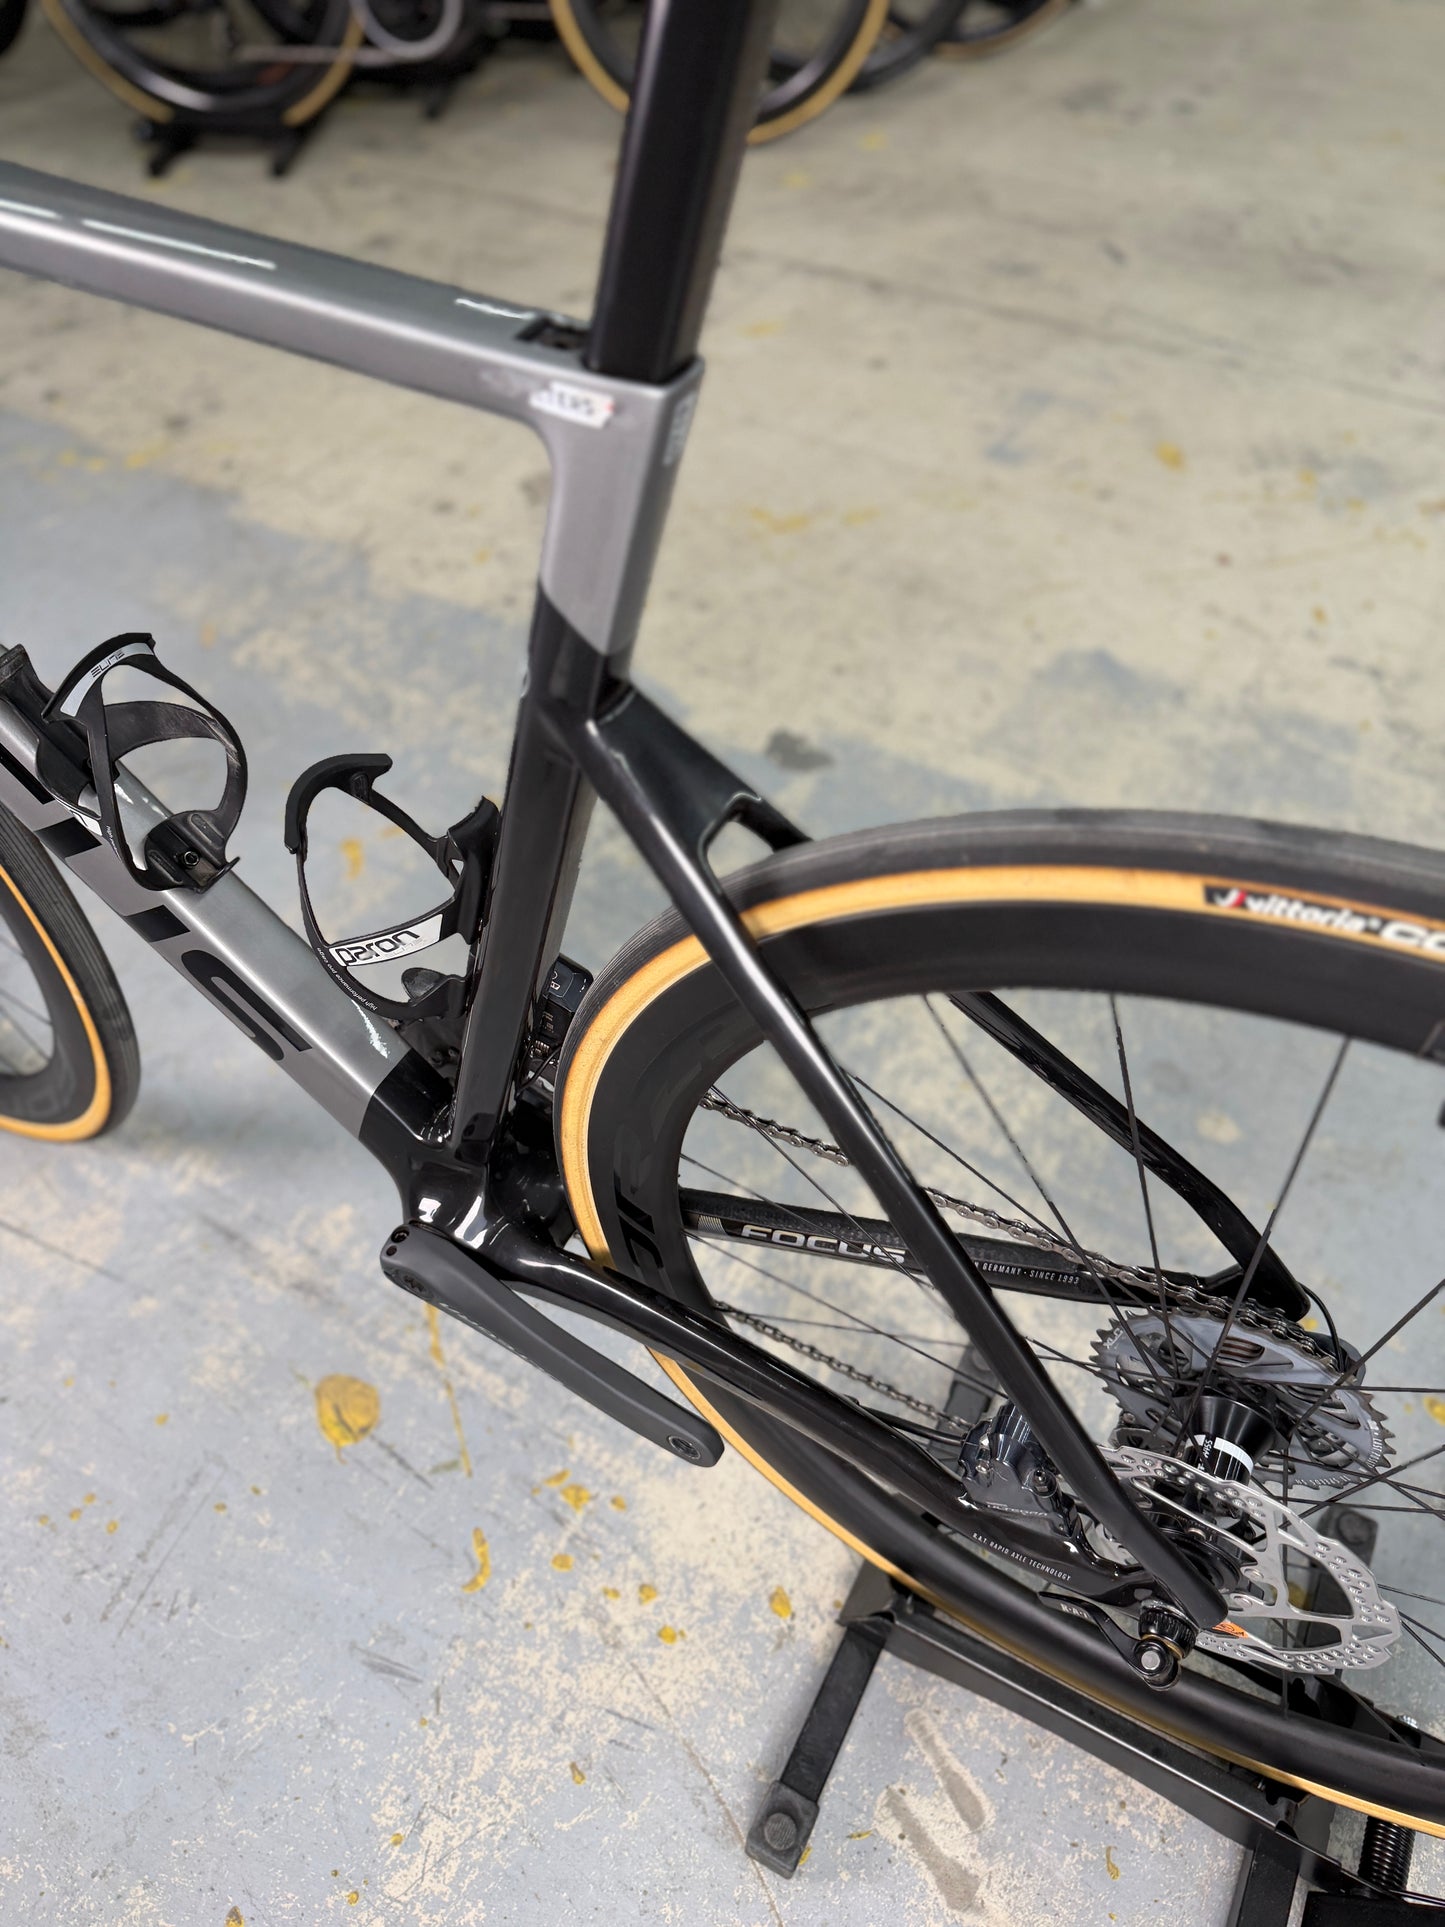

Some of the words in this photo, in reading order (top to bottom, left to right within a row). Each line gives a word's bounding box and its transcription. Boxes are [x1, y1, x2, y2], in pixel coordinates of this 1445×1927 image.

[741, 1224, 906, 1265] FOCUS
[982, 1262, 1021, 1275] GERMANY
[1029, 1270, 1055, 1281] SINCE
[1058, 1275, 1080, 1285] 1993
[990, 1541, 1009, 1555] RAPID
[1011, 1551, 1026, 1563] AXLE
[1029, 1559, 1072, 1581] TECHNOLOGY
